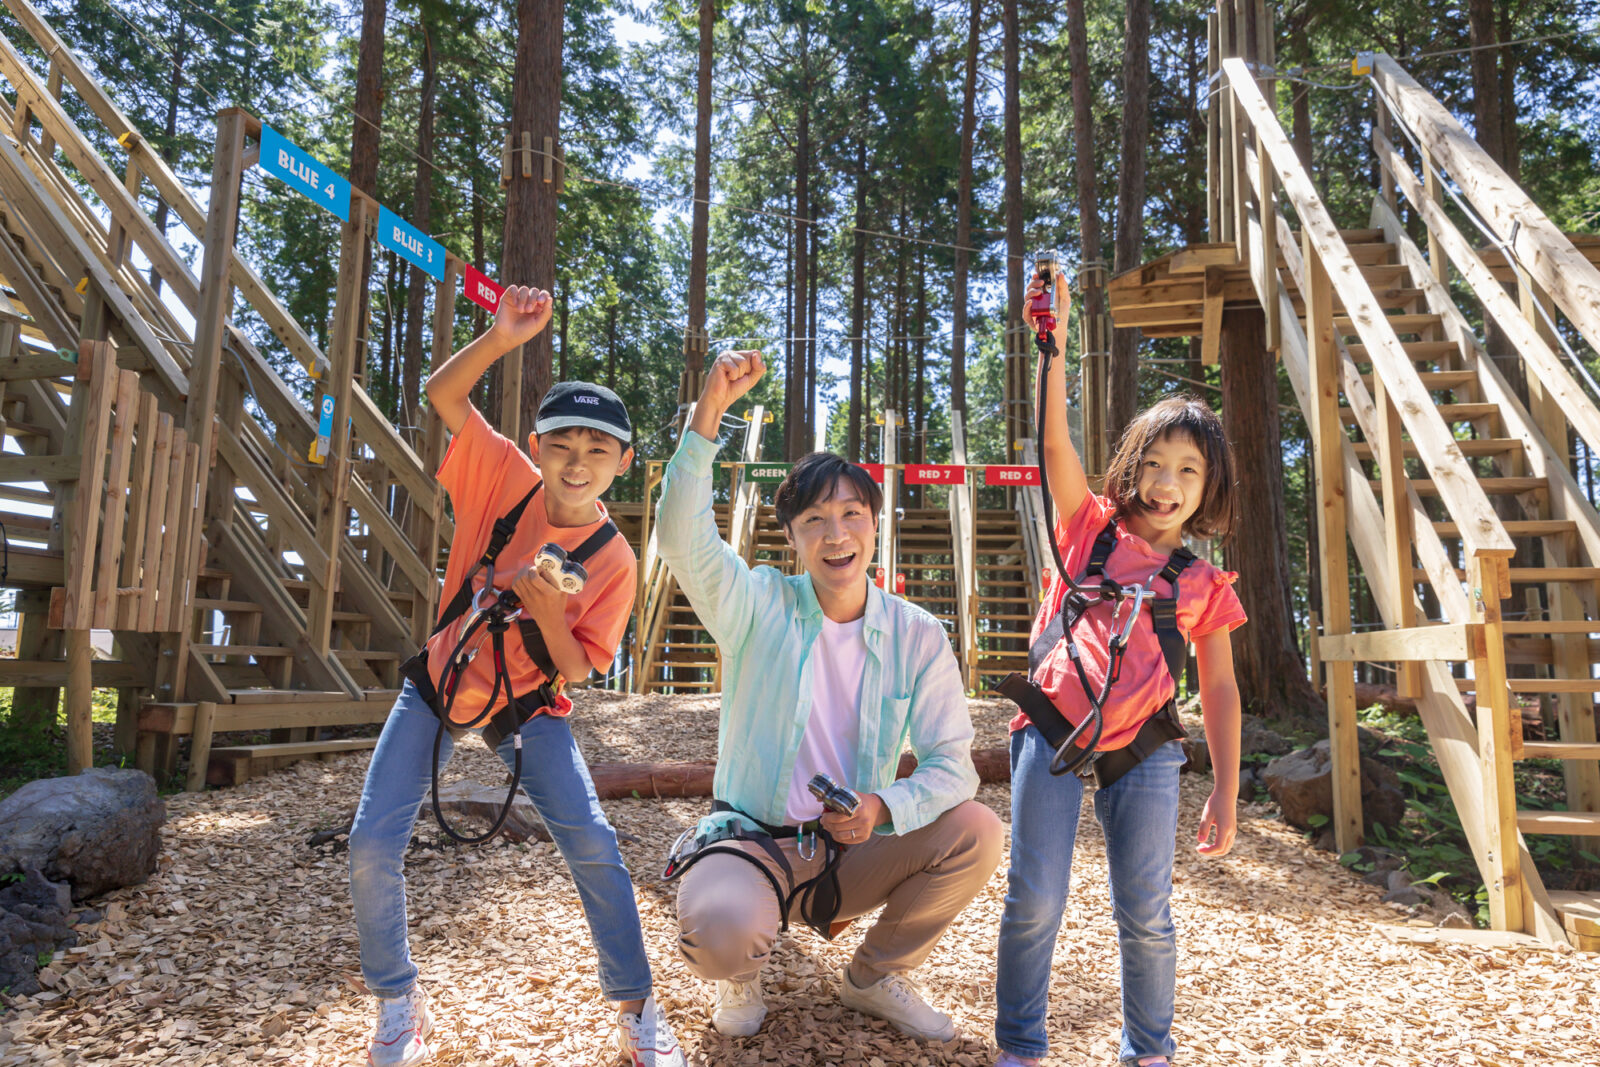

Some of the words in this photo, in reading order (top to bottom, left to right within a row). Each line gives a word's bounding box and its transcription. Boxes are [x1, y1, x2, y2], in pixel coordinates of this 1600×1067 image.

[278, 148, 319, 190] BLUE
[324, 183, 335, 200] 4
[393, 225, 424, 258] BLUE
[477, 281, 497, 305] RED
[573, 395, 600, 406] VANS
[751, 468, 787, 478] GREEN
[918, 470, 941, 479] RED
[943, 470, 952, 479] 7
[999, 471, 1022, 481] RED
[1025, 471, 1033, 481] 6
